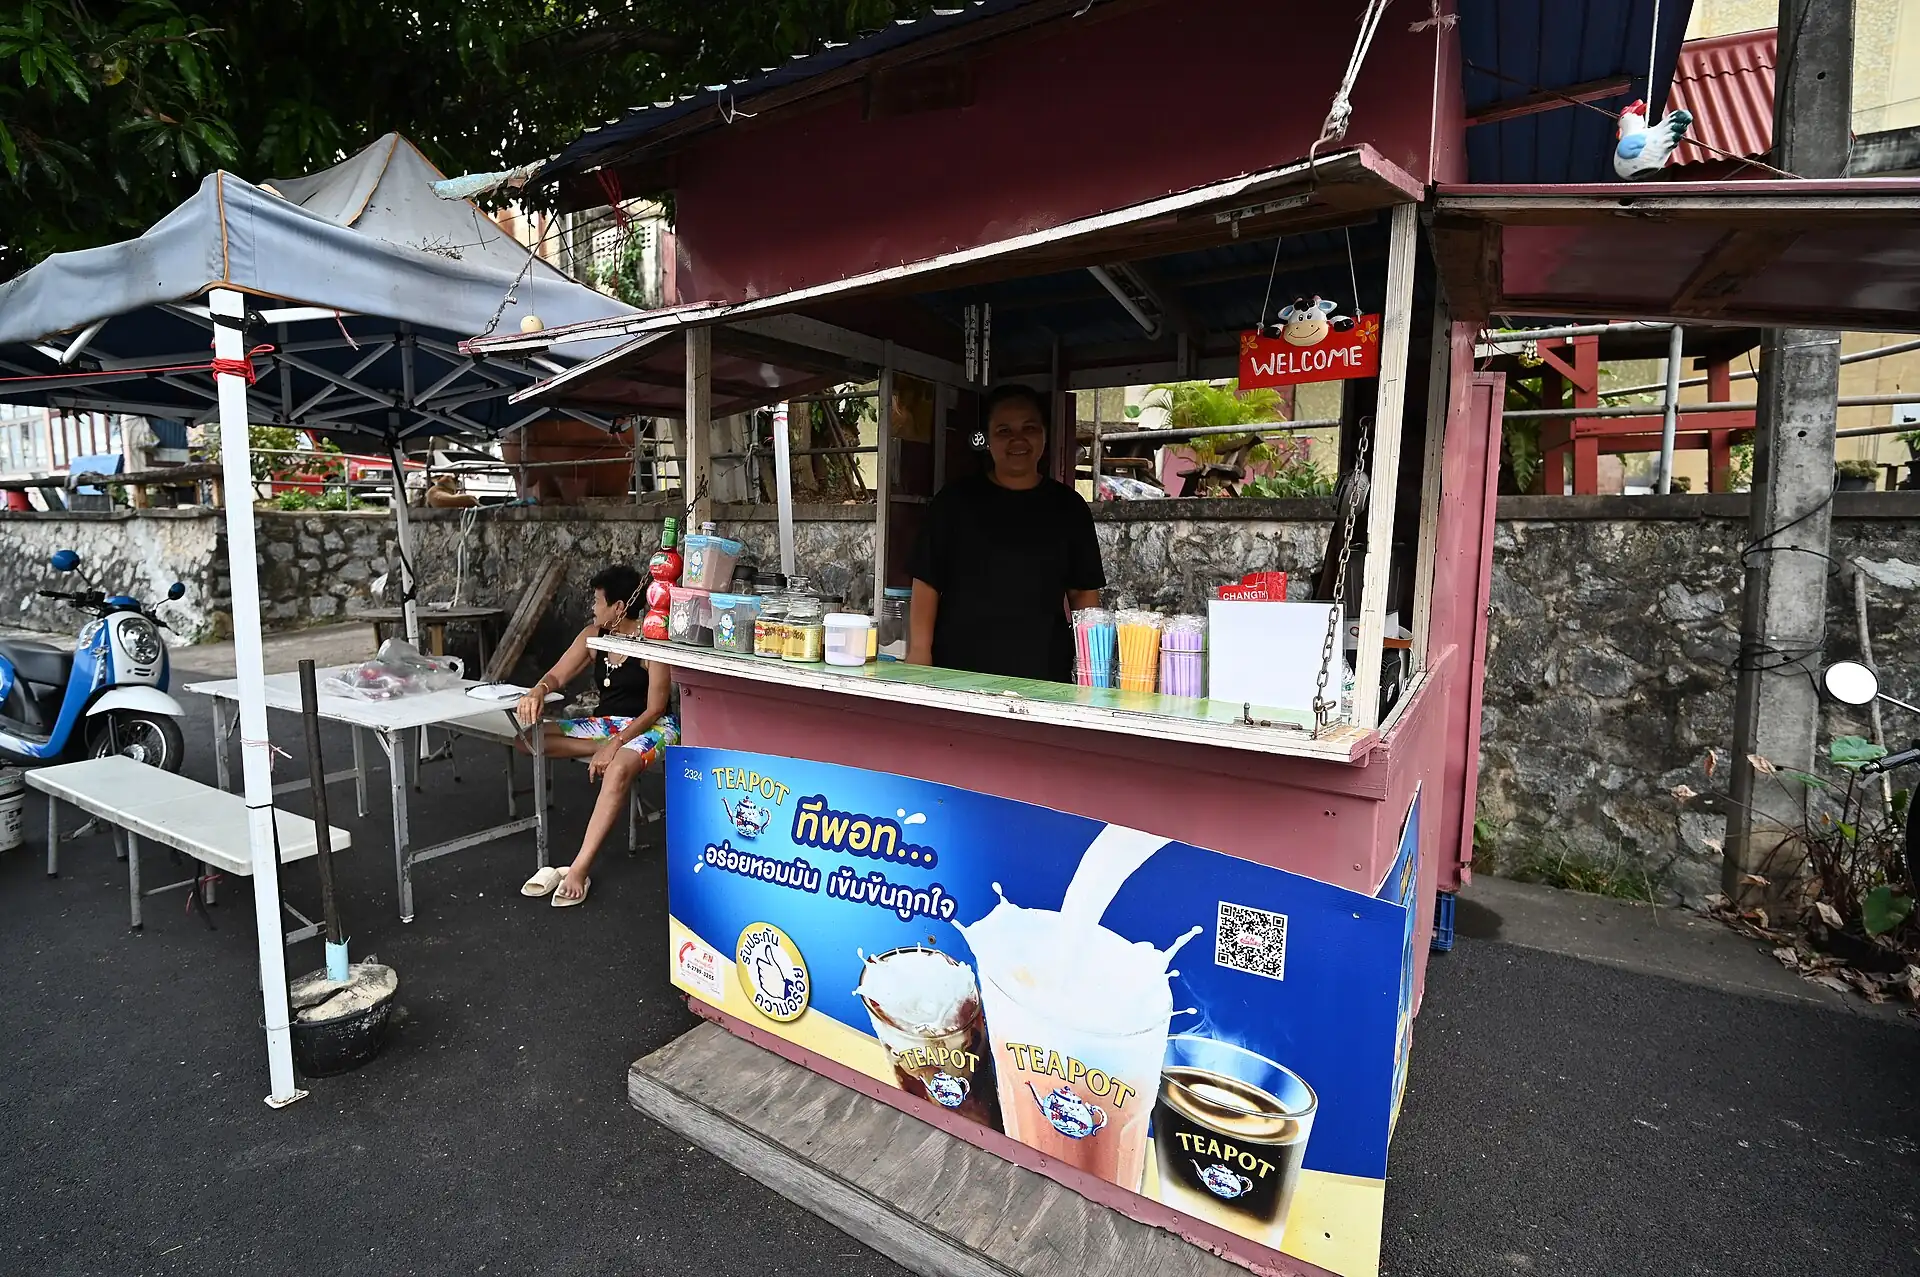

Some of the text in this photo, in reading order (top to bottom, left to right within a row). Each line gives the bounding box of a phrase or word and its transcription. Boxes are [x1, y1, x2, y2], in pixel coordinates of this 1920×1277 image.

[1250, 345, 1363, 376] WELCOME
[684, 767, 703, 782] 2324
[711, 766, 790, 806] TEAPOT
[705, 842, 956, 919] อร่อยหอมมัน เข้มข้นถูกใจ
[899, 1046, 980, 1073] TEAPOT
[1006, 1042, 1136, 1109] TEAPOT
[1175, 1132, 1276, 1178] TEAPOT
